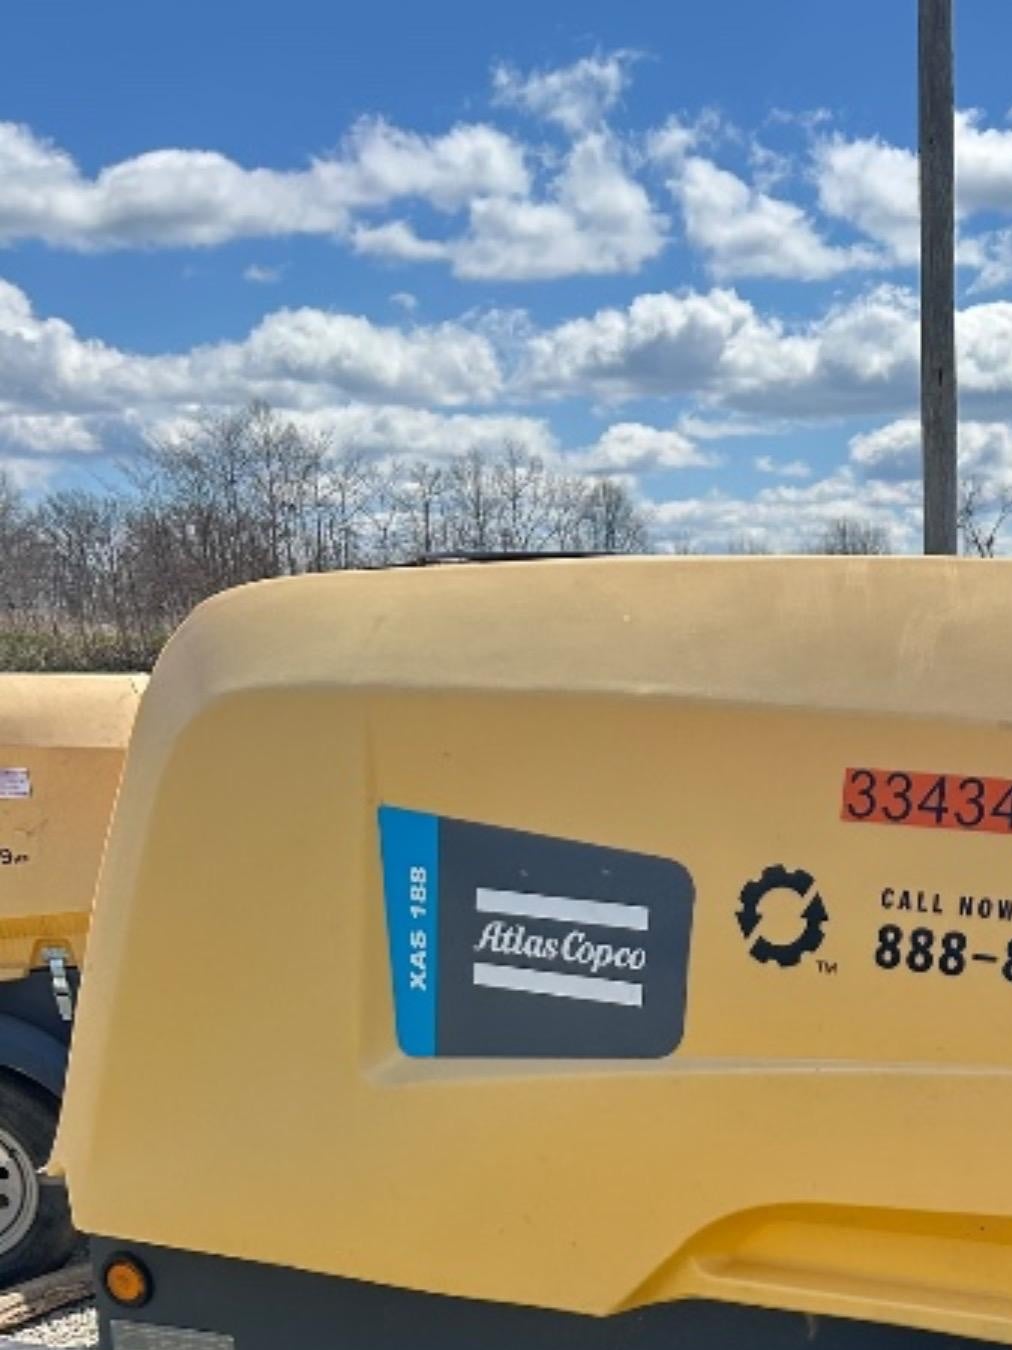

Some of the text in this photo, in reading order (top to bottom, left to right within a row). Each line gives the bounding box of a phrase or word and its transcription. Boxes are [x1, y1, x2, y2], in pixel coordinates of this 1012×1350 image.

[881, 887, 943, 914] CALL
[409, 866, 428, 992] XAS 188
[473, 919, 647, 973] Atlas Copco
